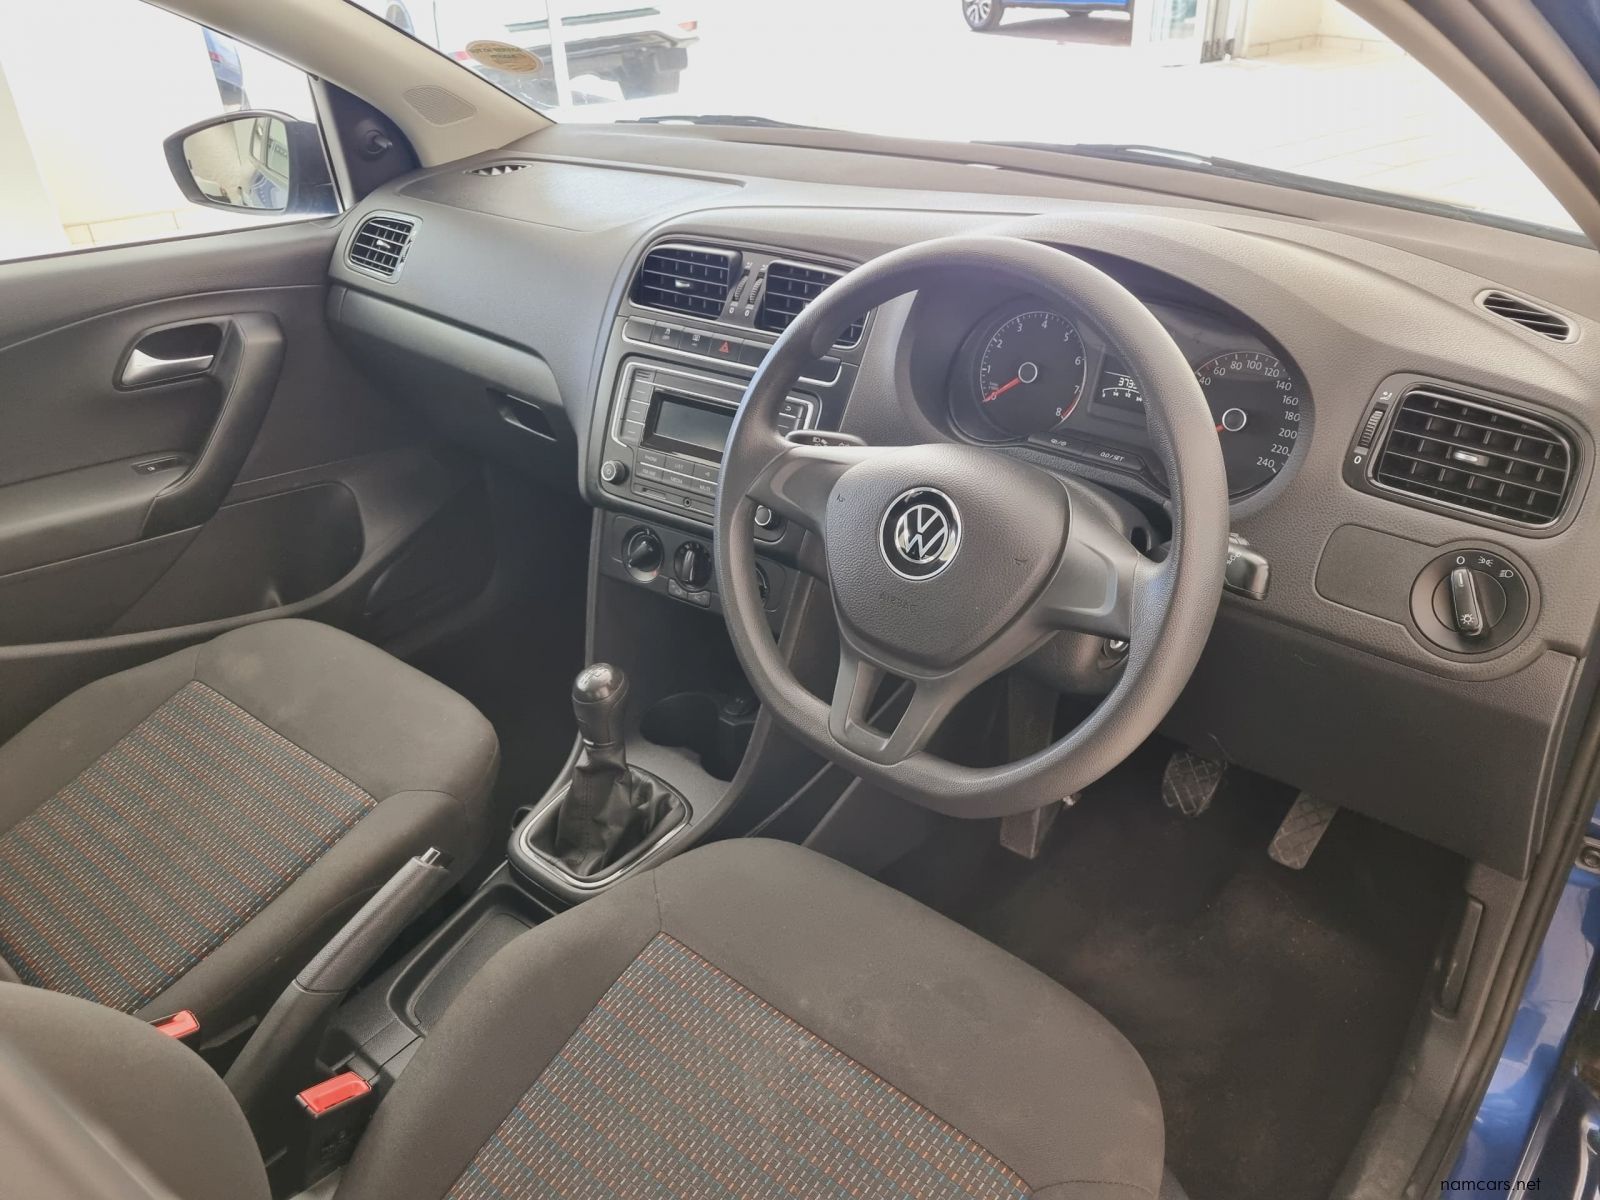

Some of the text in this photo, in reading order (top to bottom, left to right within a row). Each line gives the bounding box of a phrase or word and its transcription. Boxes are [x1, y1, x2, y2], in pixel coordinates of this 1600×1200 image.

[1017, 323, 1023, 332] 3
[1041, 320, 1048, 328] 4
[1063, 332, 1069, 342] 5
[996, 339, 1003, 348] 2
[1074, 356, 1081, 365] 6
[1246, 360, 1262, 370] 100
[1230, 361, 1242, 370] 80
[1213, 367, 1226, 376] 60
[1264, 367, 1279, 377] 120
[1199, 376, 1211, 385] 40
[1073, 385, 1080, 394] 7
[1276, 380, 1292, 391] 140
[1282, 395, 1299, 406] 160
[1055, 407, 1062, 416] 8
[1284, 411, 1300, 421] 180
[1278, 427, 1298, 439] 200
[1270, 443, 1289, 455] 220
[1256, 456, 1275, 468] 240
